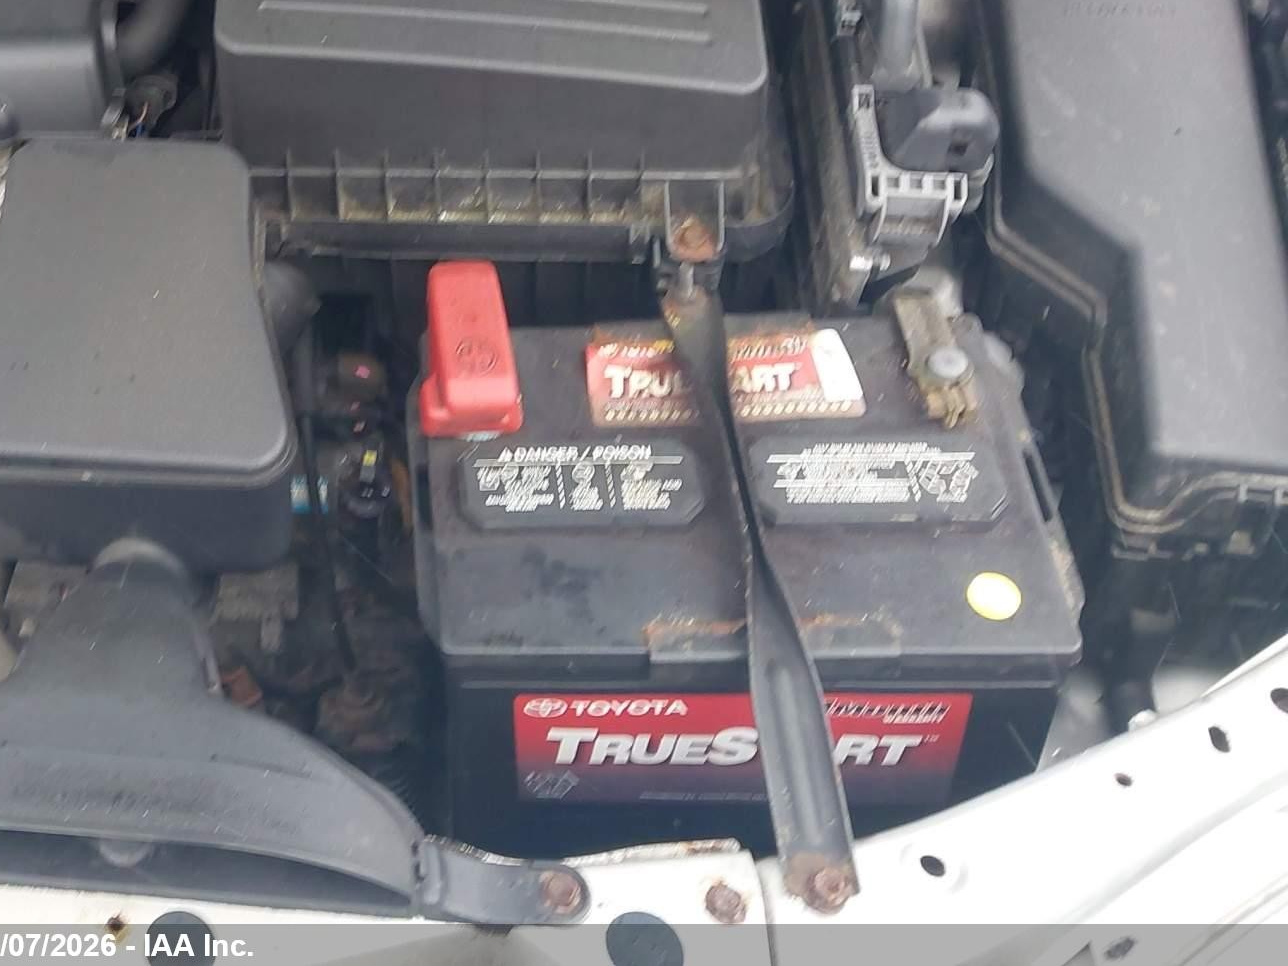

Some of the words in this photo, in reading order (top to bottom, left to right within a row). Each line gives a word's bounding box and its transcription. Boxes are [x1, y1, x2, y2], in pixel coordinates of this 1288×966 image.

[604, 361, 798, 399] TRUART
[569, 698, 689, 717] TOYOTA
[545, 726, 923, 766] TRUESRT
